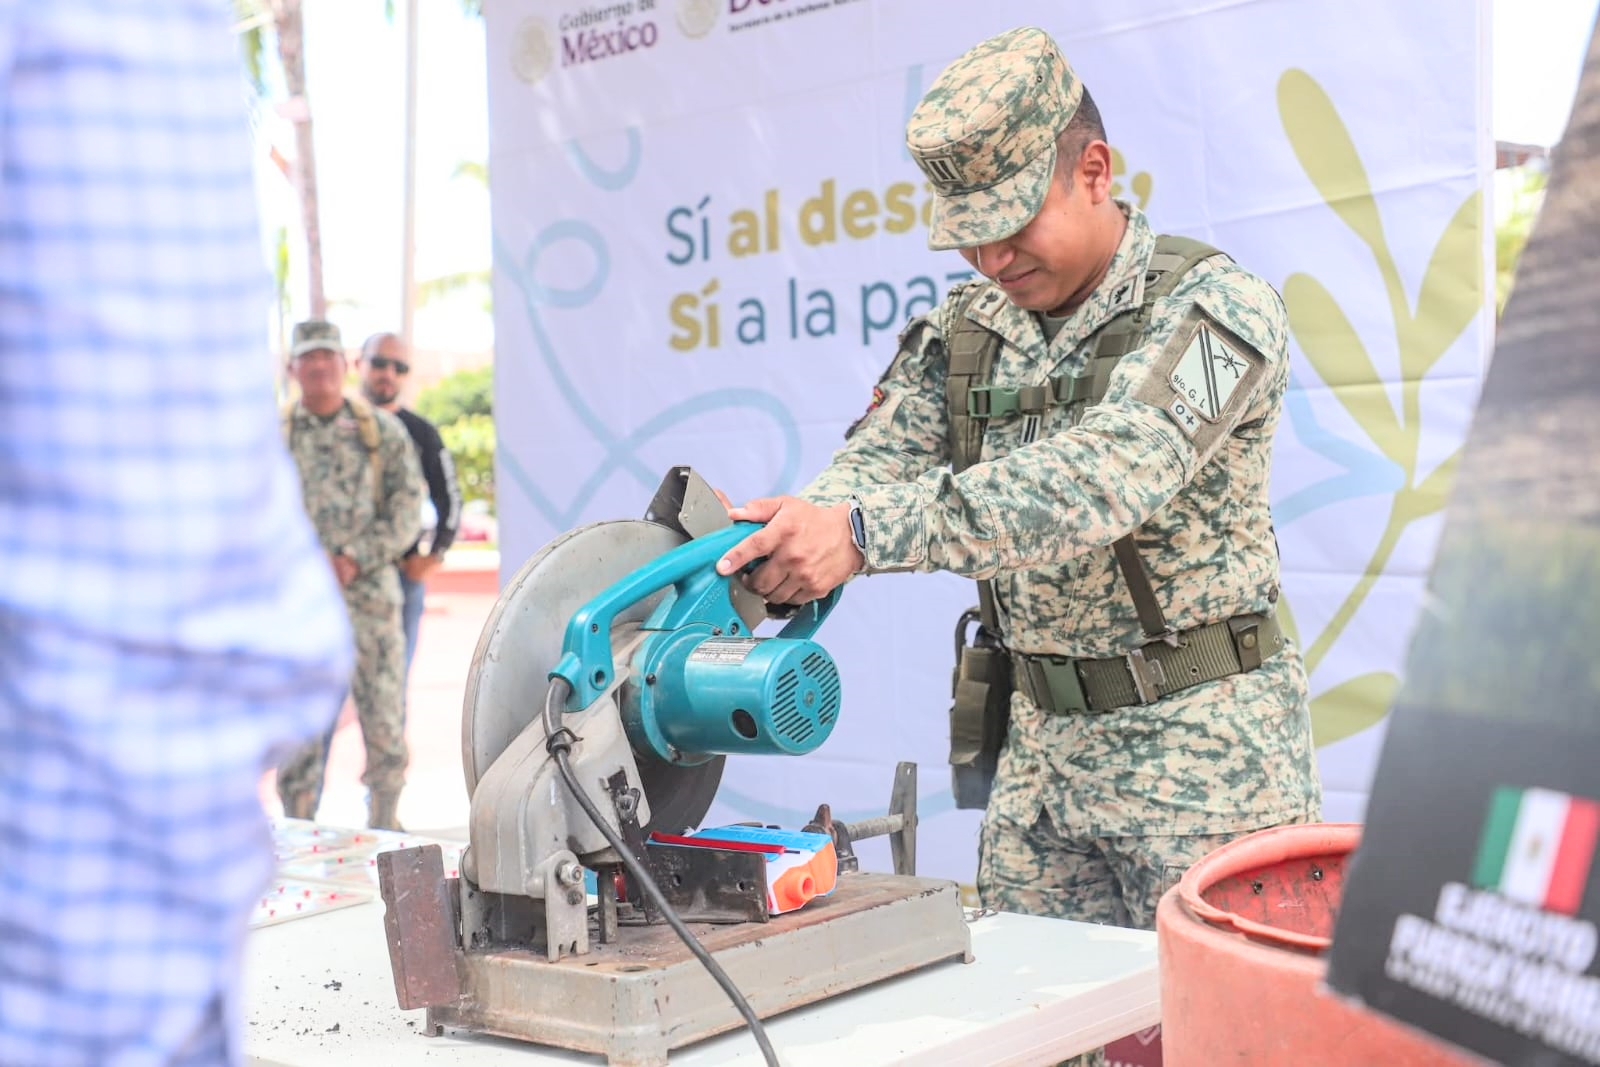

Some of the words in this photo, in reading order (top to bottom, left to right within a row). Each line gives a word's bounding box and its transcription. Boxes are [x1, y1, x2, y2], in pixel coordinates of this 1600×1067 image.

[562, 20, 658, 67] México
[666, 195, 711, 266] Sí
[727, 189, 780, 259] al
[668, 277, 720, 353] Sí
[736, 297, 766, 345] a
[788, 276, 837, 340] la
